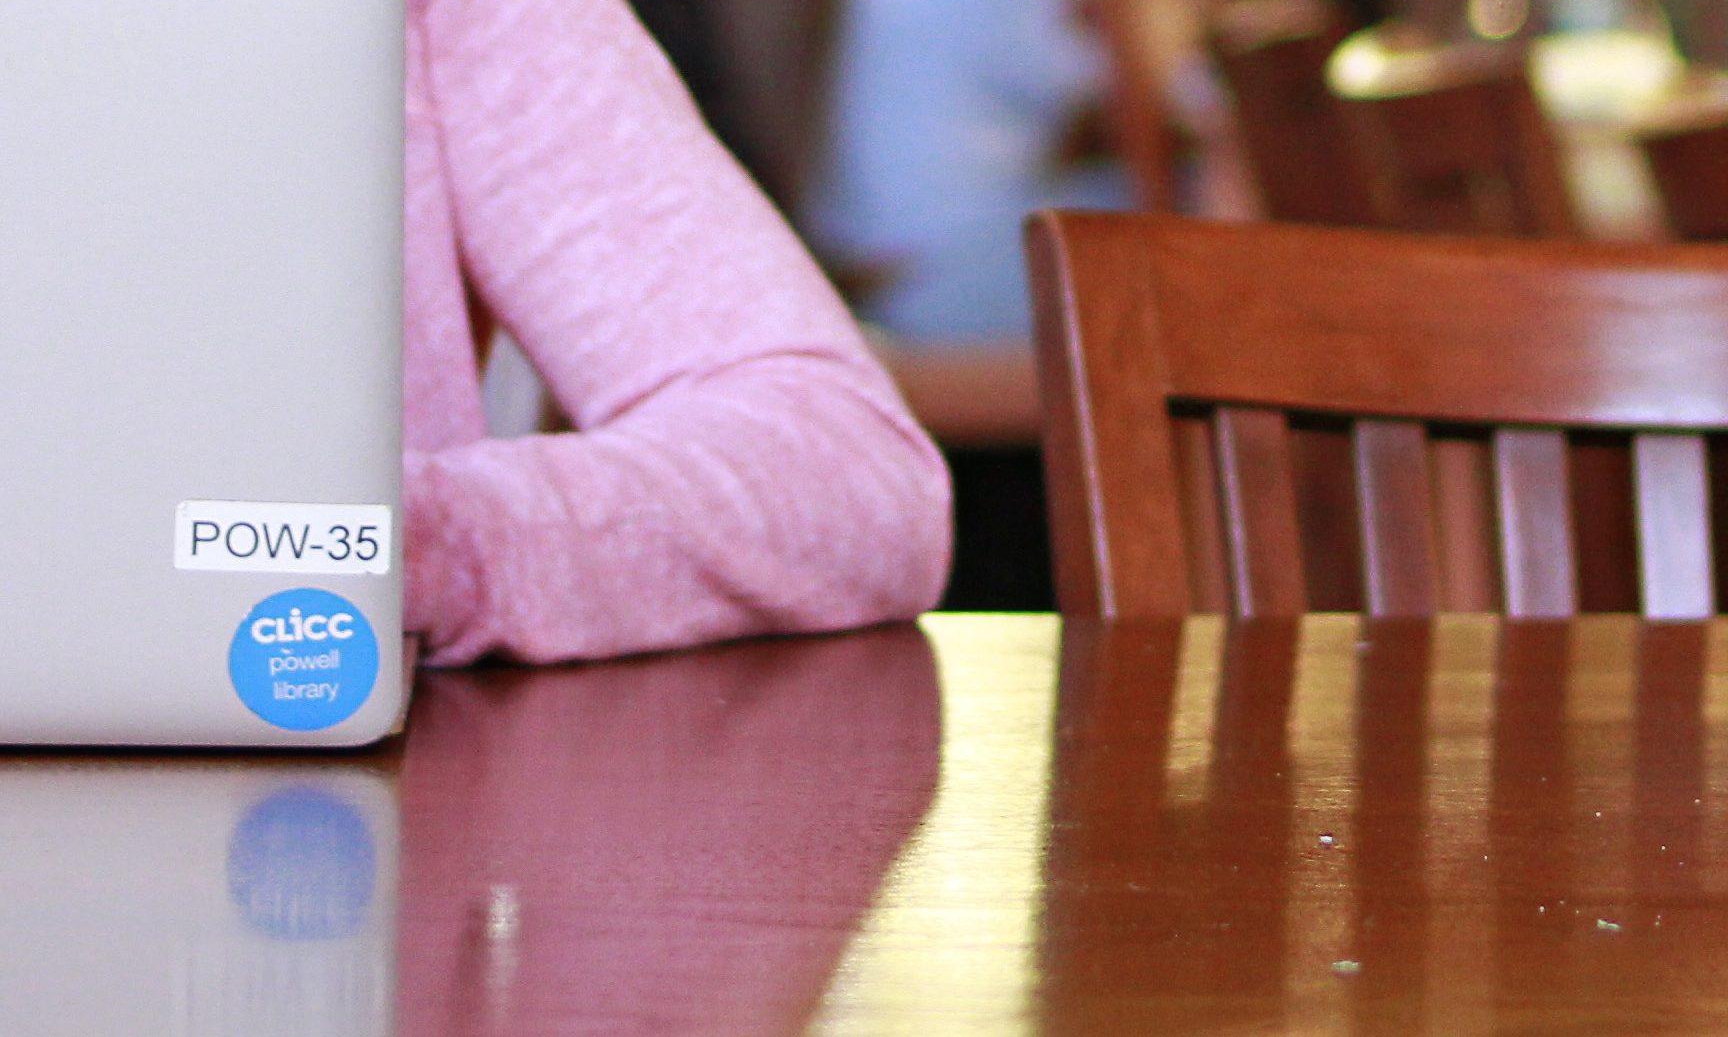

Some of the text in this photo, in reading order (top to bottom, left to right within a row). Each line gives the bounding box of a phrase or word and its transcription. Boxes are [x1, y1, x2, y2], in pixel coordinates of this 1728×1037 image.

[191, 521, 379, 561] POW-35
[269, 649, 340, 676] powell
[274, 682, 340, 701] library
